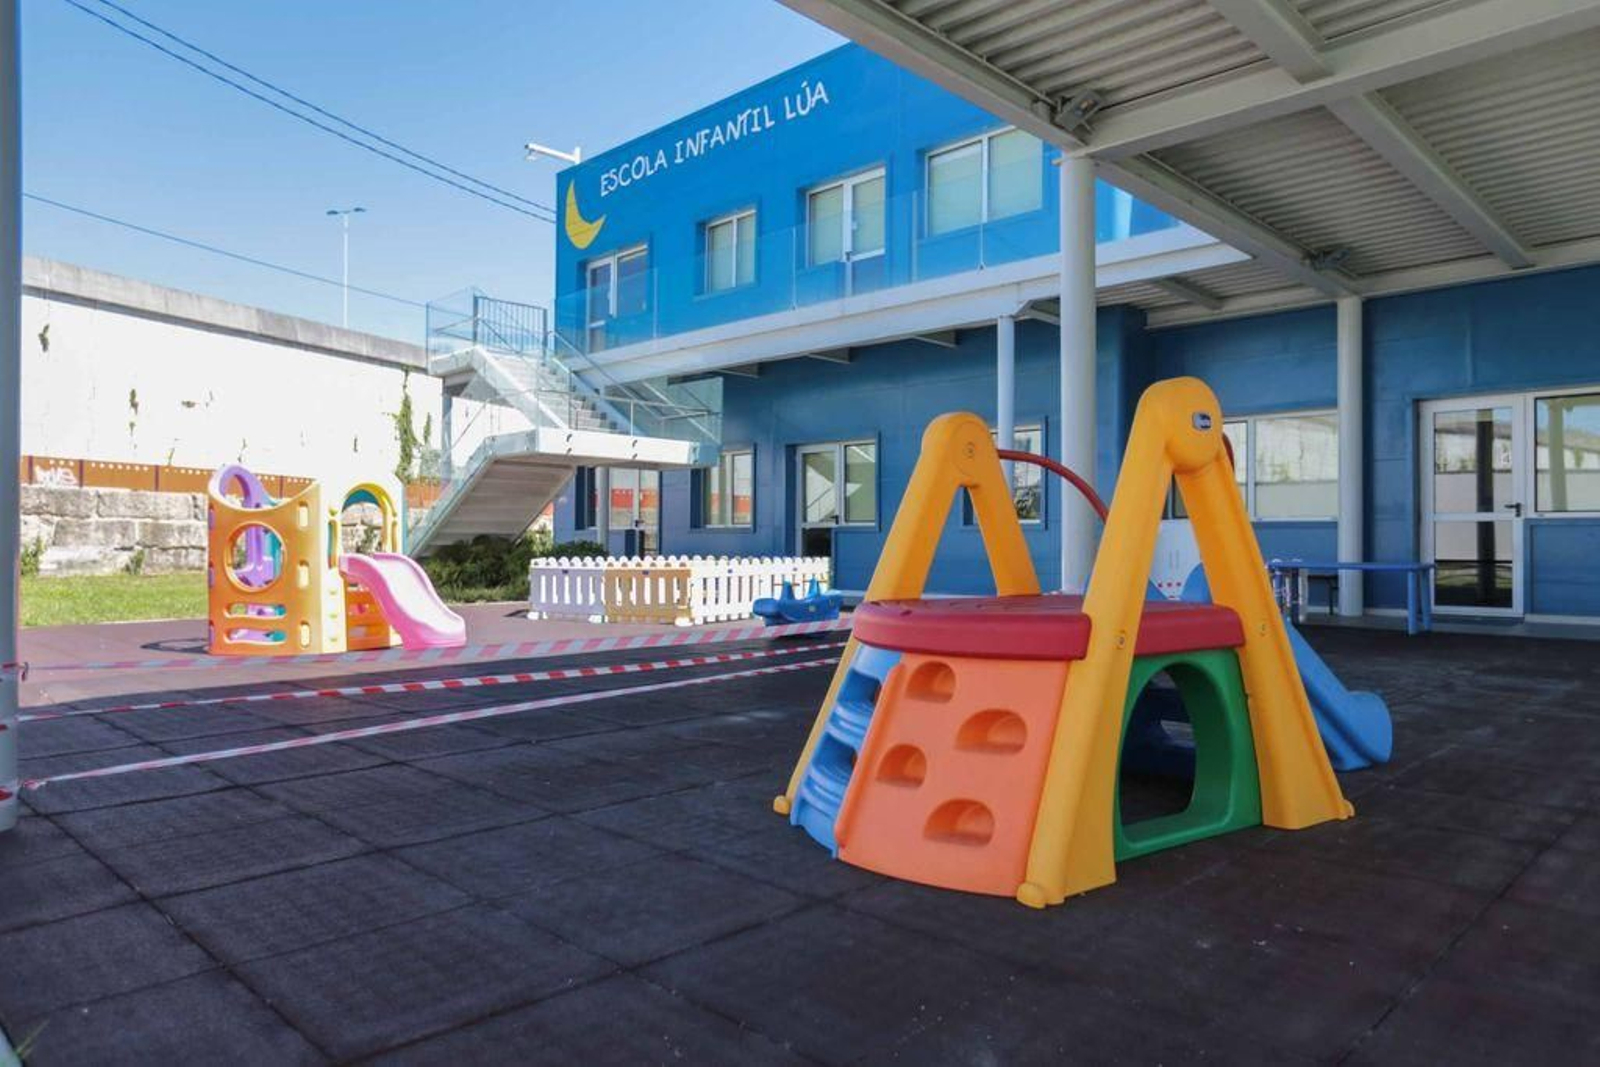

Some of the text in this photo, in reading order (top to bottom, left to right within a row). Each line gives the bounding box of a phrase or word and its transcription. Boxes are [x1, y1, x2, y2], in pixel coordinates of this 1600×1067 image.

[600, 80, 829, 197] ESCOLA INFANTIL LÚA
